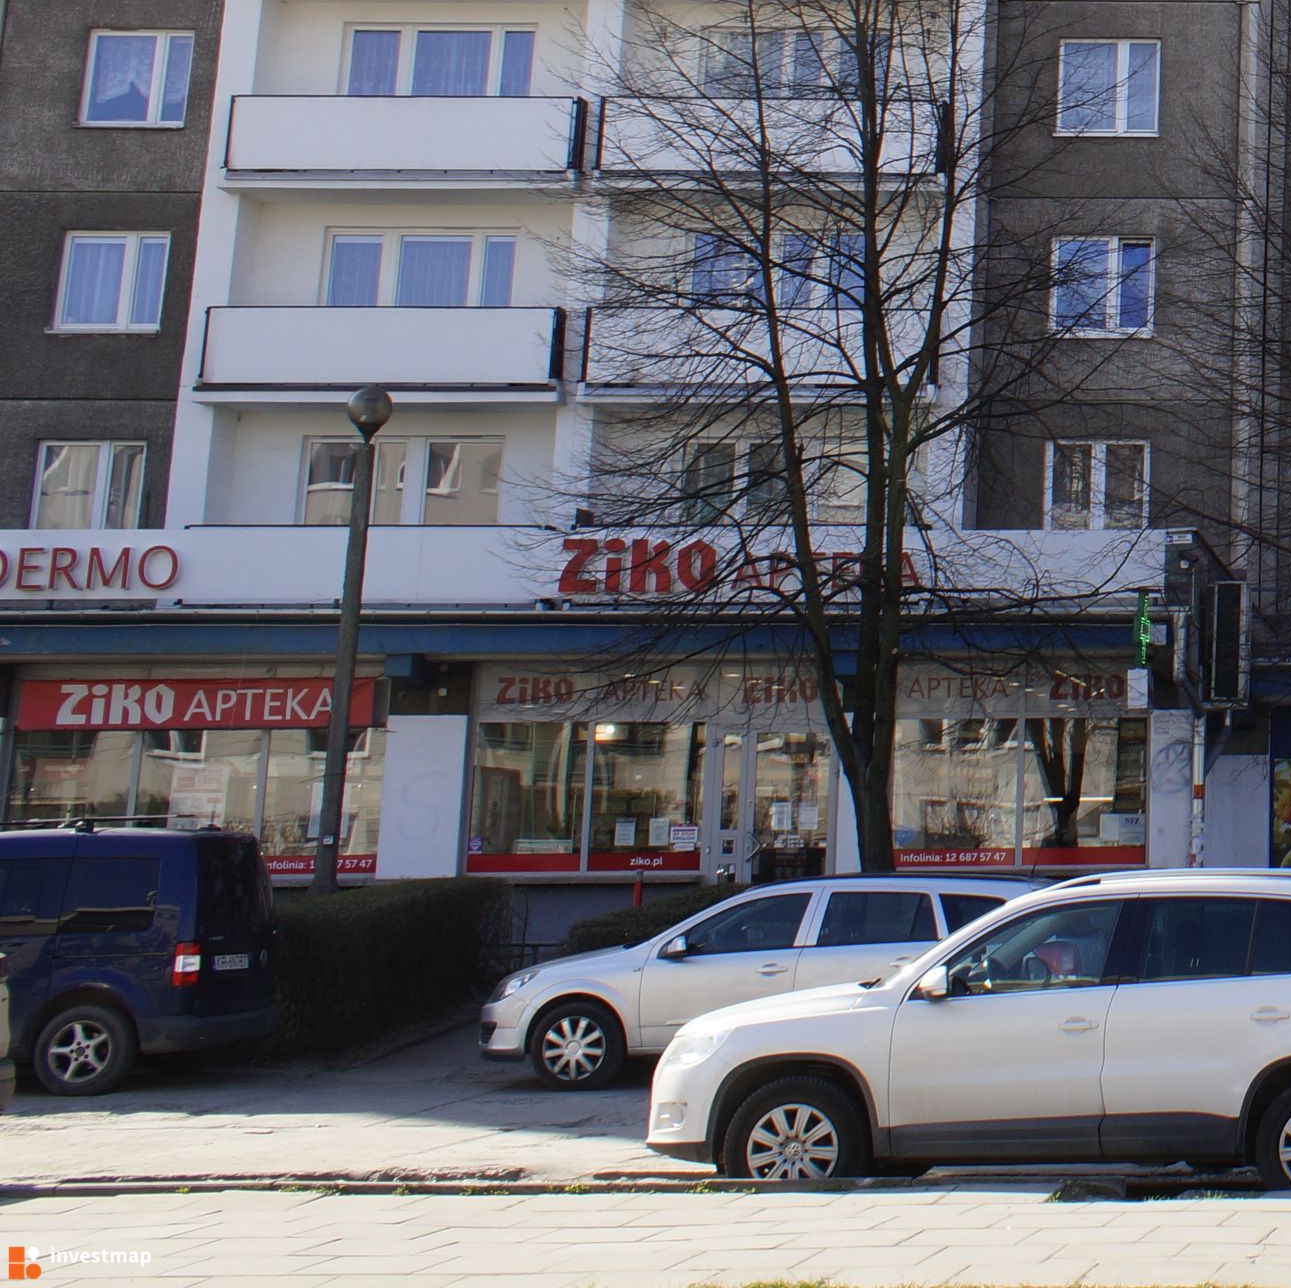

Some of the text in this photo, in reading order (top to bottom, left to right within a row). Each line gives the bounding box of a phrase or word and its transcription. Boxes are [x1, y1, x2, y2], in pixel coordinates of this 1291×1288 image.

[0, 545, 180, 590] ERMO
[731, 551, 920, 590] APEA
[604, 679, 710, 702] APTEKA
[907, 677, 1009, 699] APTEKA
[183, 687, 333, 721] APTEKA
[267, 860, 307, 870] nfolinia:
[345, 859, 358, 869] 57
[359, 859, 373, 869] 47
[630, 856, 663, 866] ziko.pl
[900, 851, 1007, 863] Infolinia: 12 687 57 47
